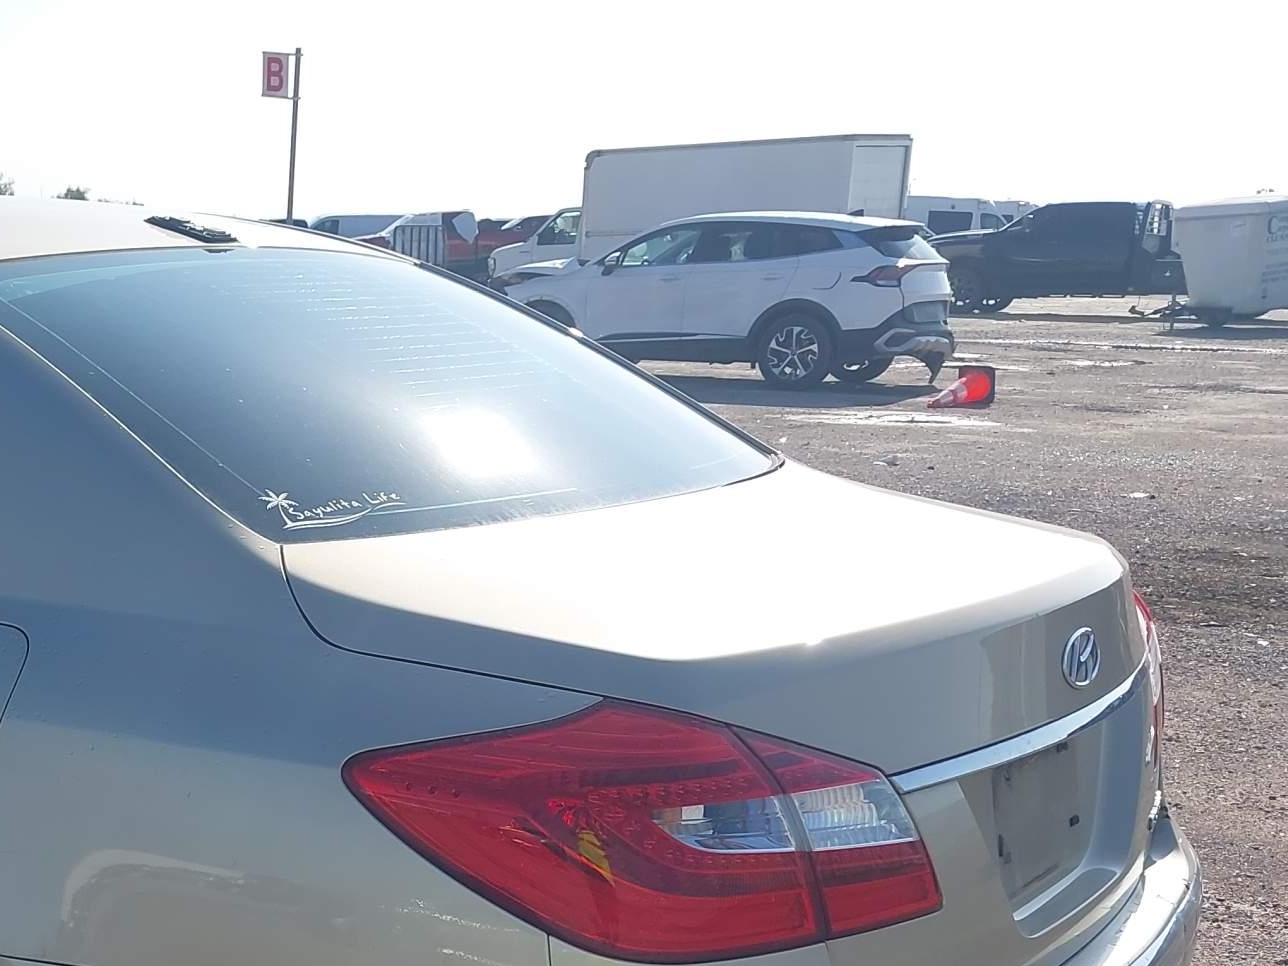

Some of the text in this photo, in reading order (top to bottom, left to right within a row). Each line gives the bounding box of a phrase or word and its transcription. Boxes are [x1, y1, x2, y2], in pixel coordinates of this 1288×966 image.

[266, 56, 284, 92] B
[288, 491, 401, 520] Sayulita Life
